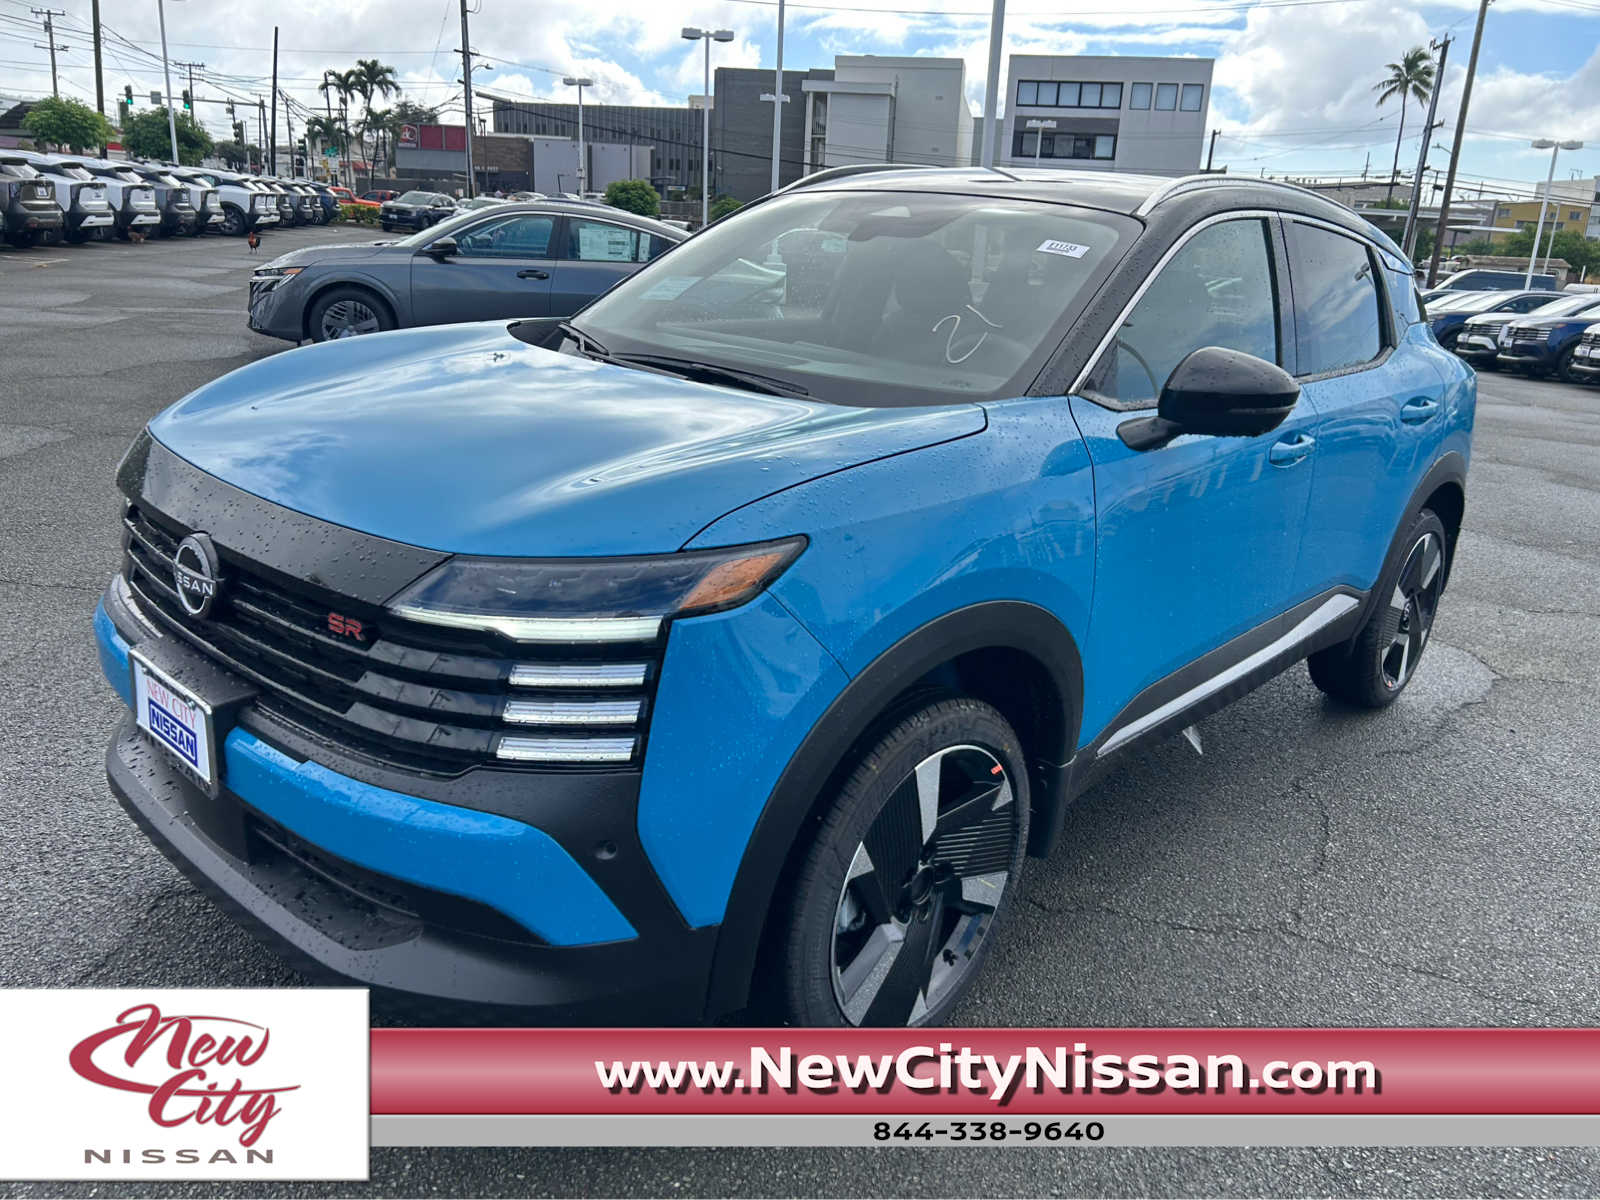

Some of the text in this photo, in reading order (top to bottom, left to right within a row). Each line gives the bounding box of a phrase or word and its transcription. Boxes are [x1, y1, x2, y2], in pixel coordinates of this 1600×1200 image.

[327, 612, 364, 641] SR
[146, 679, 196, 729] NEW CITY
[151, 708, 195, 758] NISSAN
